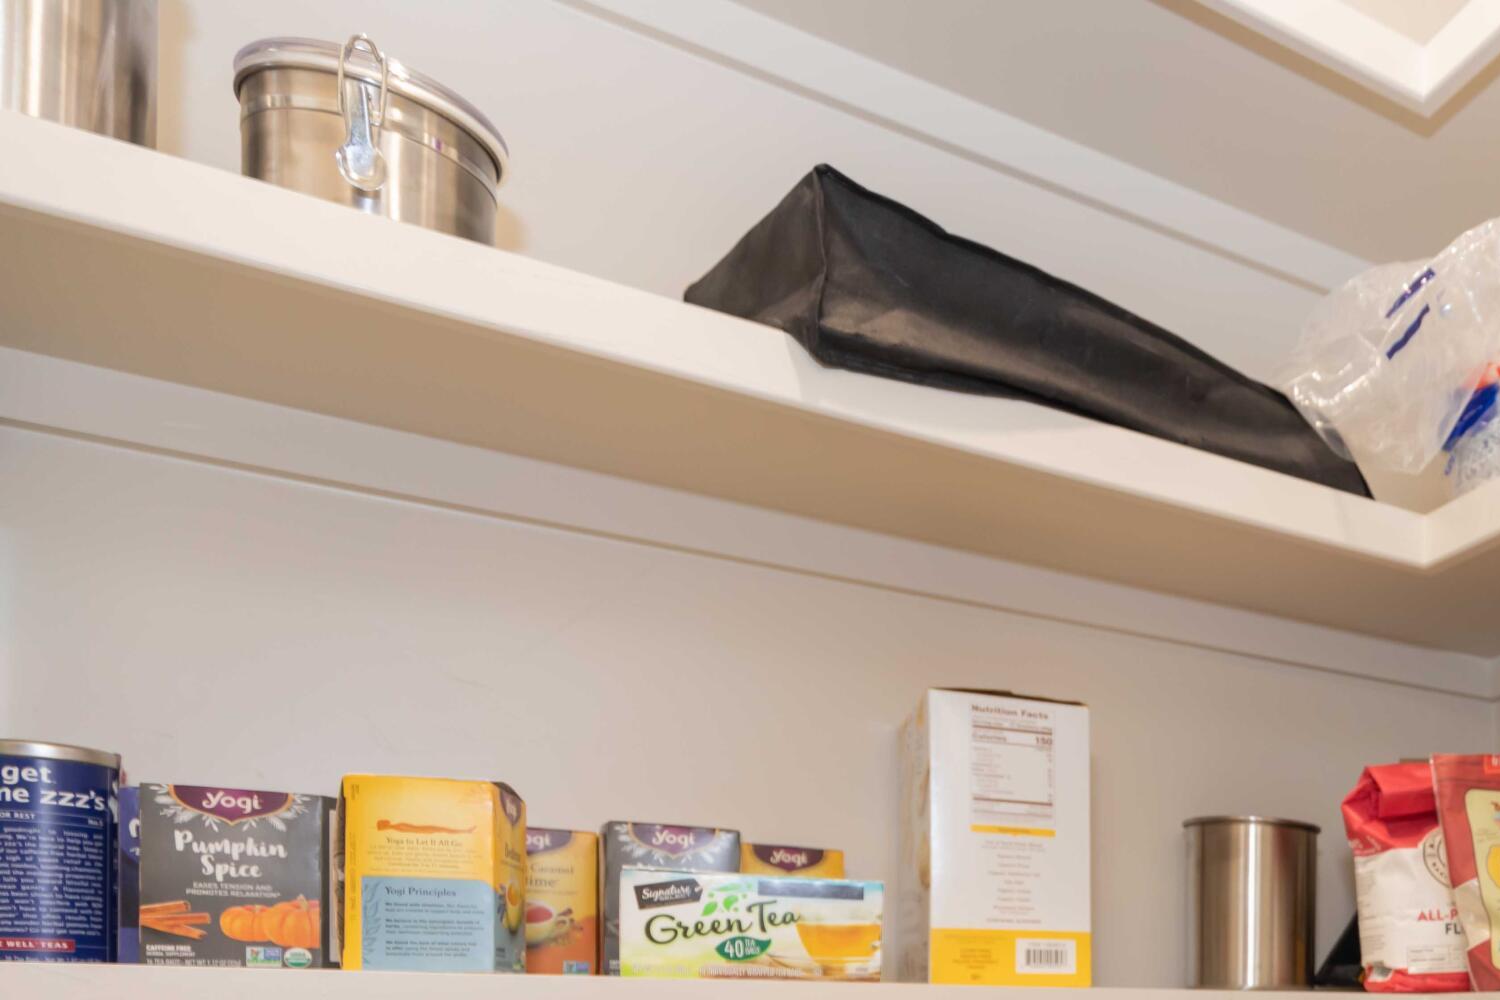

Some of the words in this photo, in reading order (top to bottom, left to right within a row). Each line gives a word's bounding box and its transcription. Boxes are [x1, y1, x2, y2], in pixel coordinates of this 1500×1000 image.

[971, 704, 1018, 716] Nutrition
[1021, 710, 1048, 720] Facts
[1, 765, 52, 785] get
[40, 789, 105, 811] zzz's
[202, 790, 262, 812] yogi
[14, 811, 36, 820] REST
[173, 829, 289, 862] Pumpkin
[652, 829, 695, 848] yogi
[770, 848, 807, 865] yogi
[201, 855, 262, 883] Spice
[186, 887, 228, 897] PROMOTES
[220, 882, 253, 891] TENSION
[385, 886, 405, 896] Yogi
[408, 886, 456, 898] Principles
[645, 913, 753, 945] Green
[746, 900, 800, 933] Tea
[724, 938, 744, 958] 40
